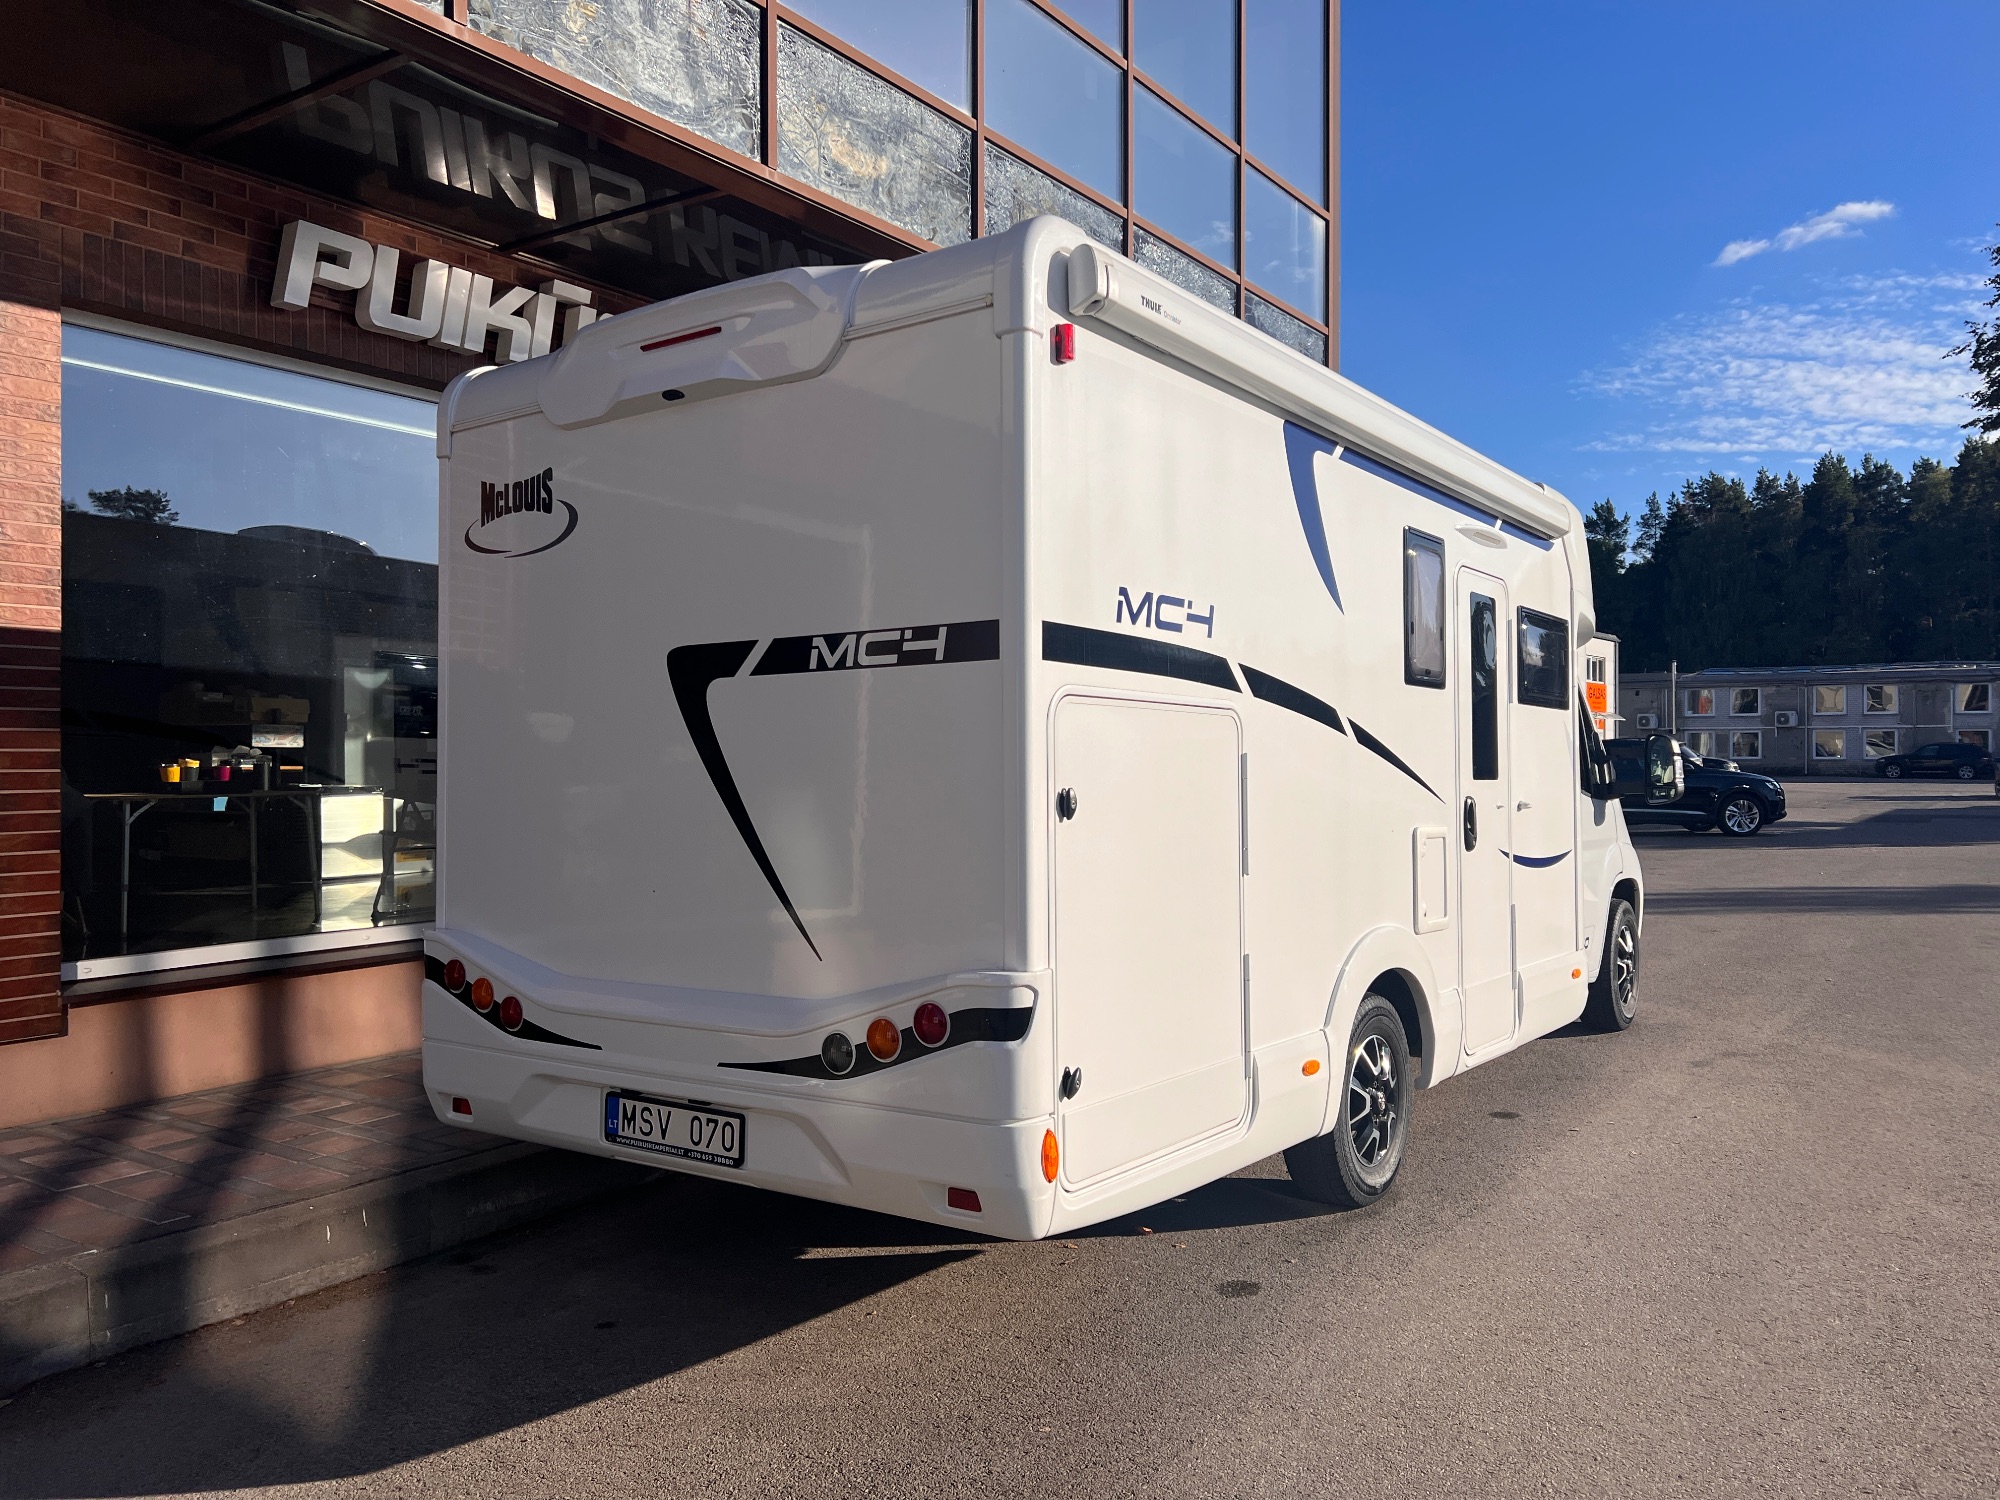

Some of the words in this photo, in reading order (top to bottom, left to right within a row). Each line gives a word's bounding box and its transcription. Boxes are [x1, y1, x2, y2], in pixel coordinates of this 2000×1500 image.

[1140, 294, 1162, 315] THULE
[608, 1118, 618, 1128] LT
[621, 1102, 672, 1140] MSV
[690, 1115, 735, 1153] 070
